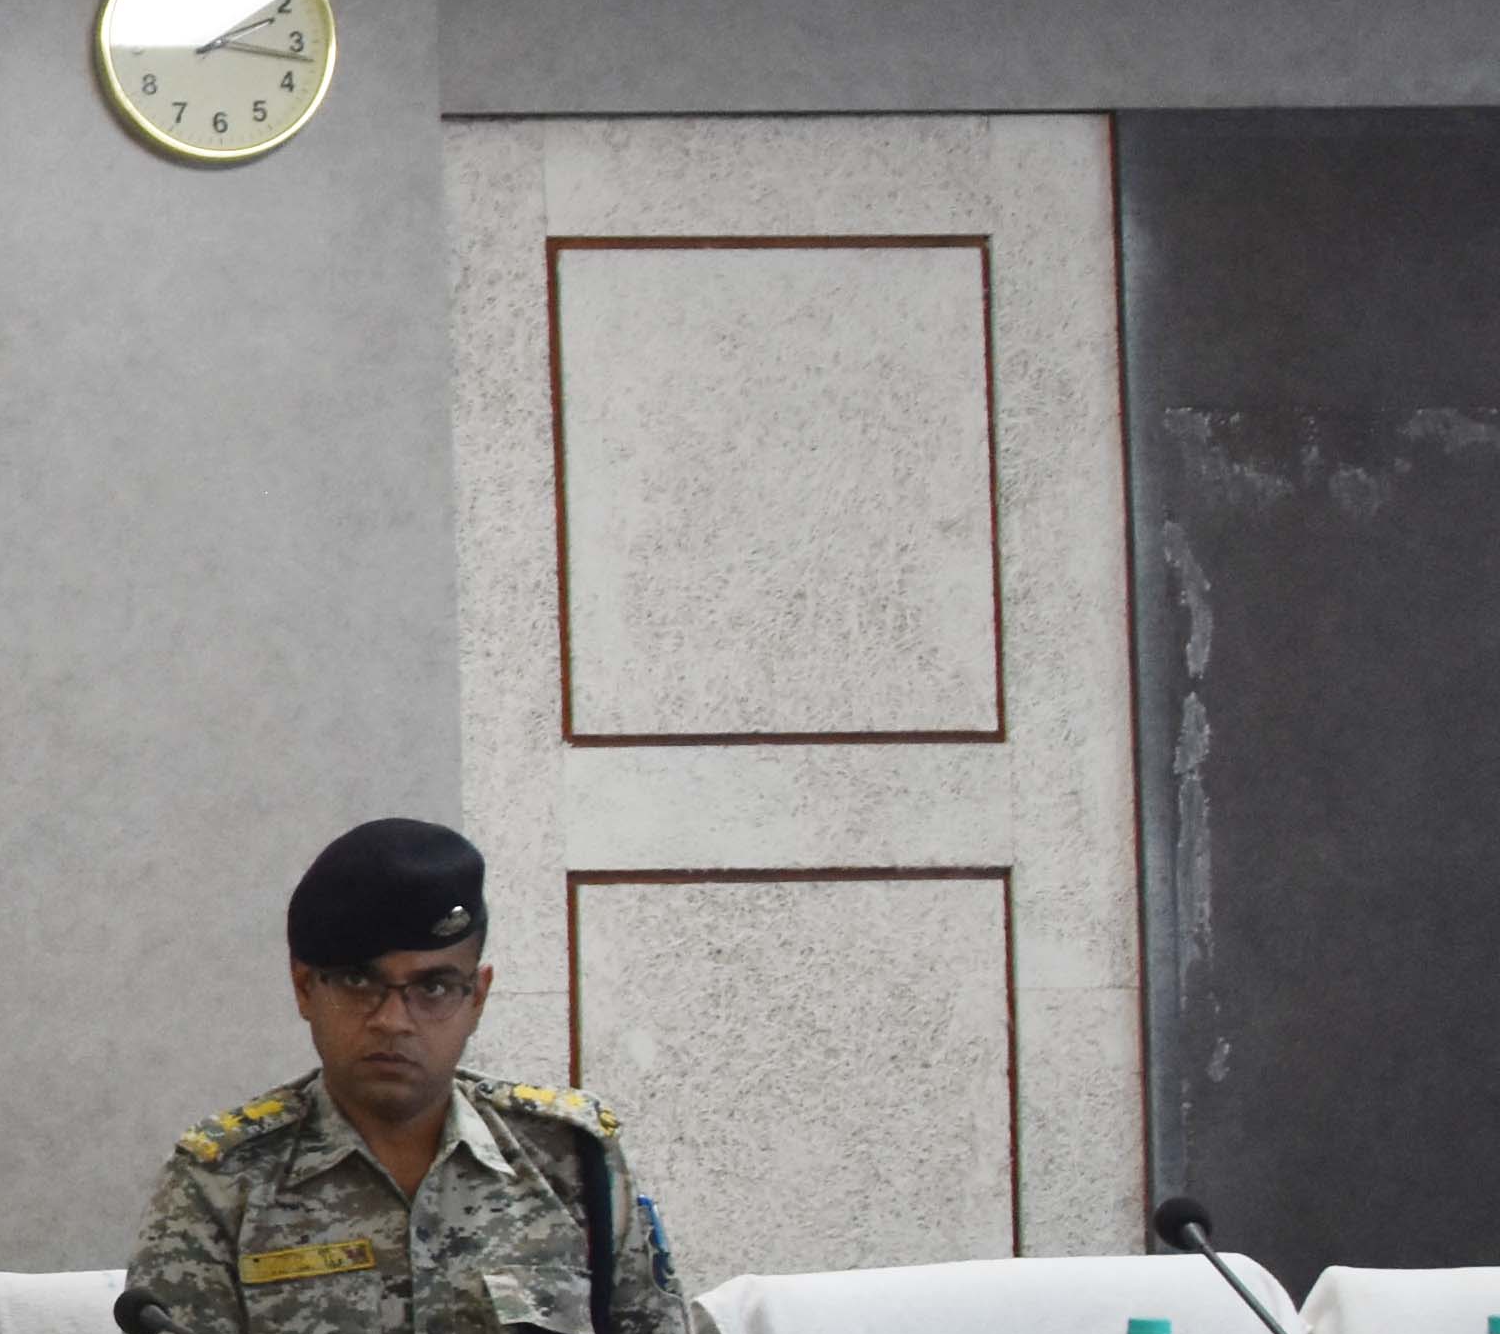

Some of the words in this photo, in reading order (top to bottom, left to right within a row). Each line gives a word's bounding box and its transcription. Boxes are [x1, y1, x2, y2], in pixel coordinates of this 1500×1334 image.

[289, 31, 304, 53] 3
[142, 74, 158, 95] 8
[280, 70, 295, 92] 4
[172, 102, 187, 123] 7
[252, 100, 267, 122] 5
[212, 112, 228, 133] 6
